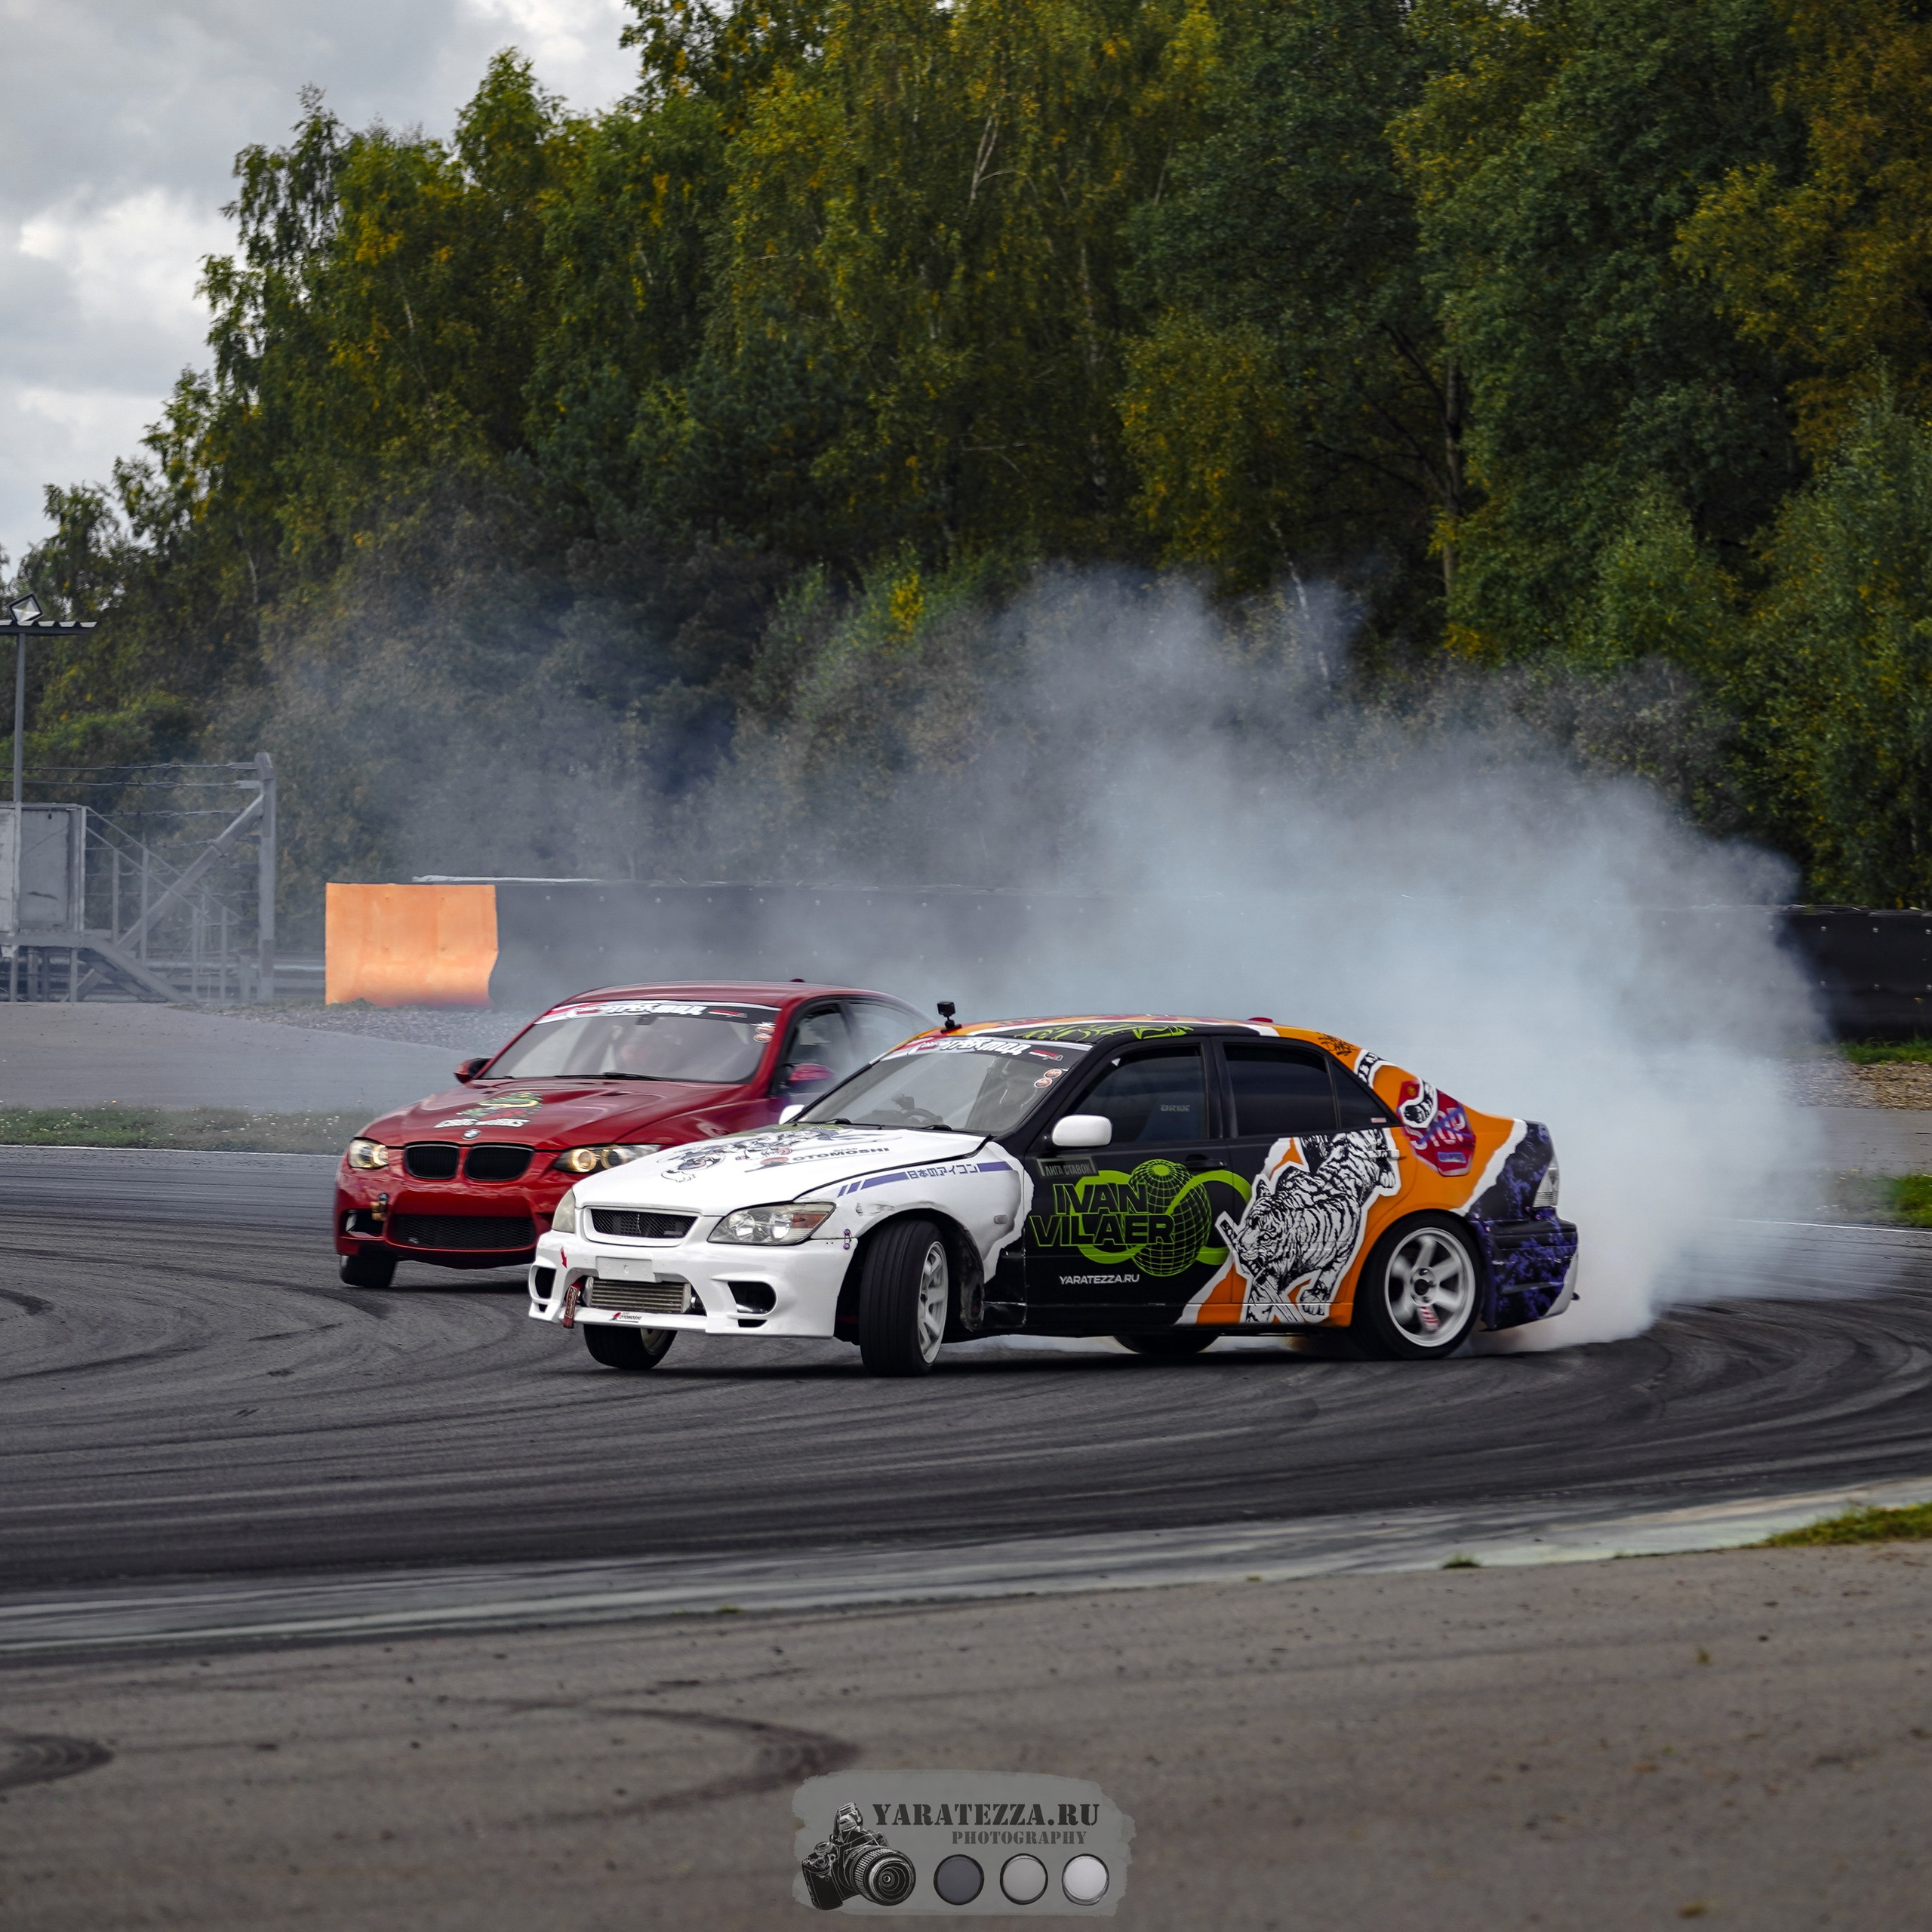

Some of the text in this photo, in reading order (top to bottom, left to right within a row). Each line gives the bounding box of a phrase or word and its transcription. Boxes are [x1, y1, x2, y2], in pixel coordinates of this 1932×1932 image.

[792, 1147, 890, 1161] OTOMOSHI
[1052, 1183, 1149, 1215] IVAN
[1029, 1214, 1175, 1247] VILAER
[1059, 1273, 1140, 1284] YARATEZZA.RU
